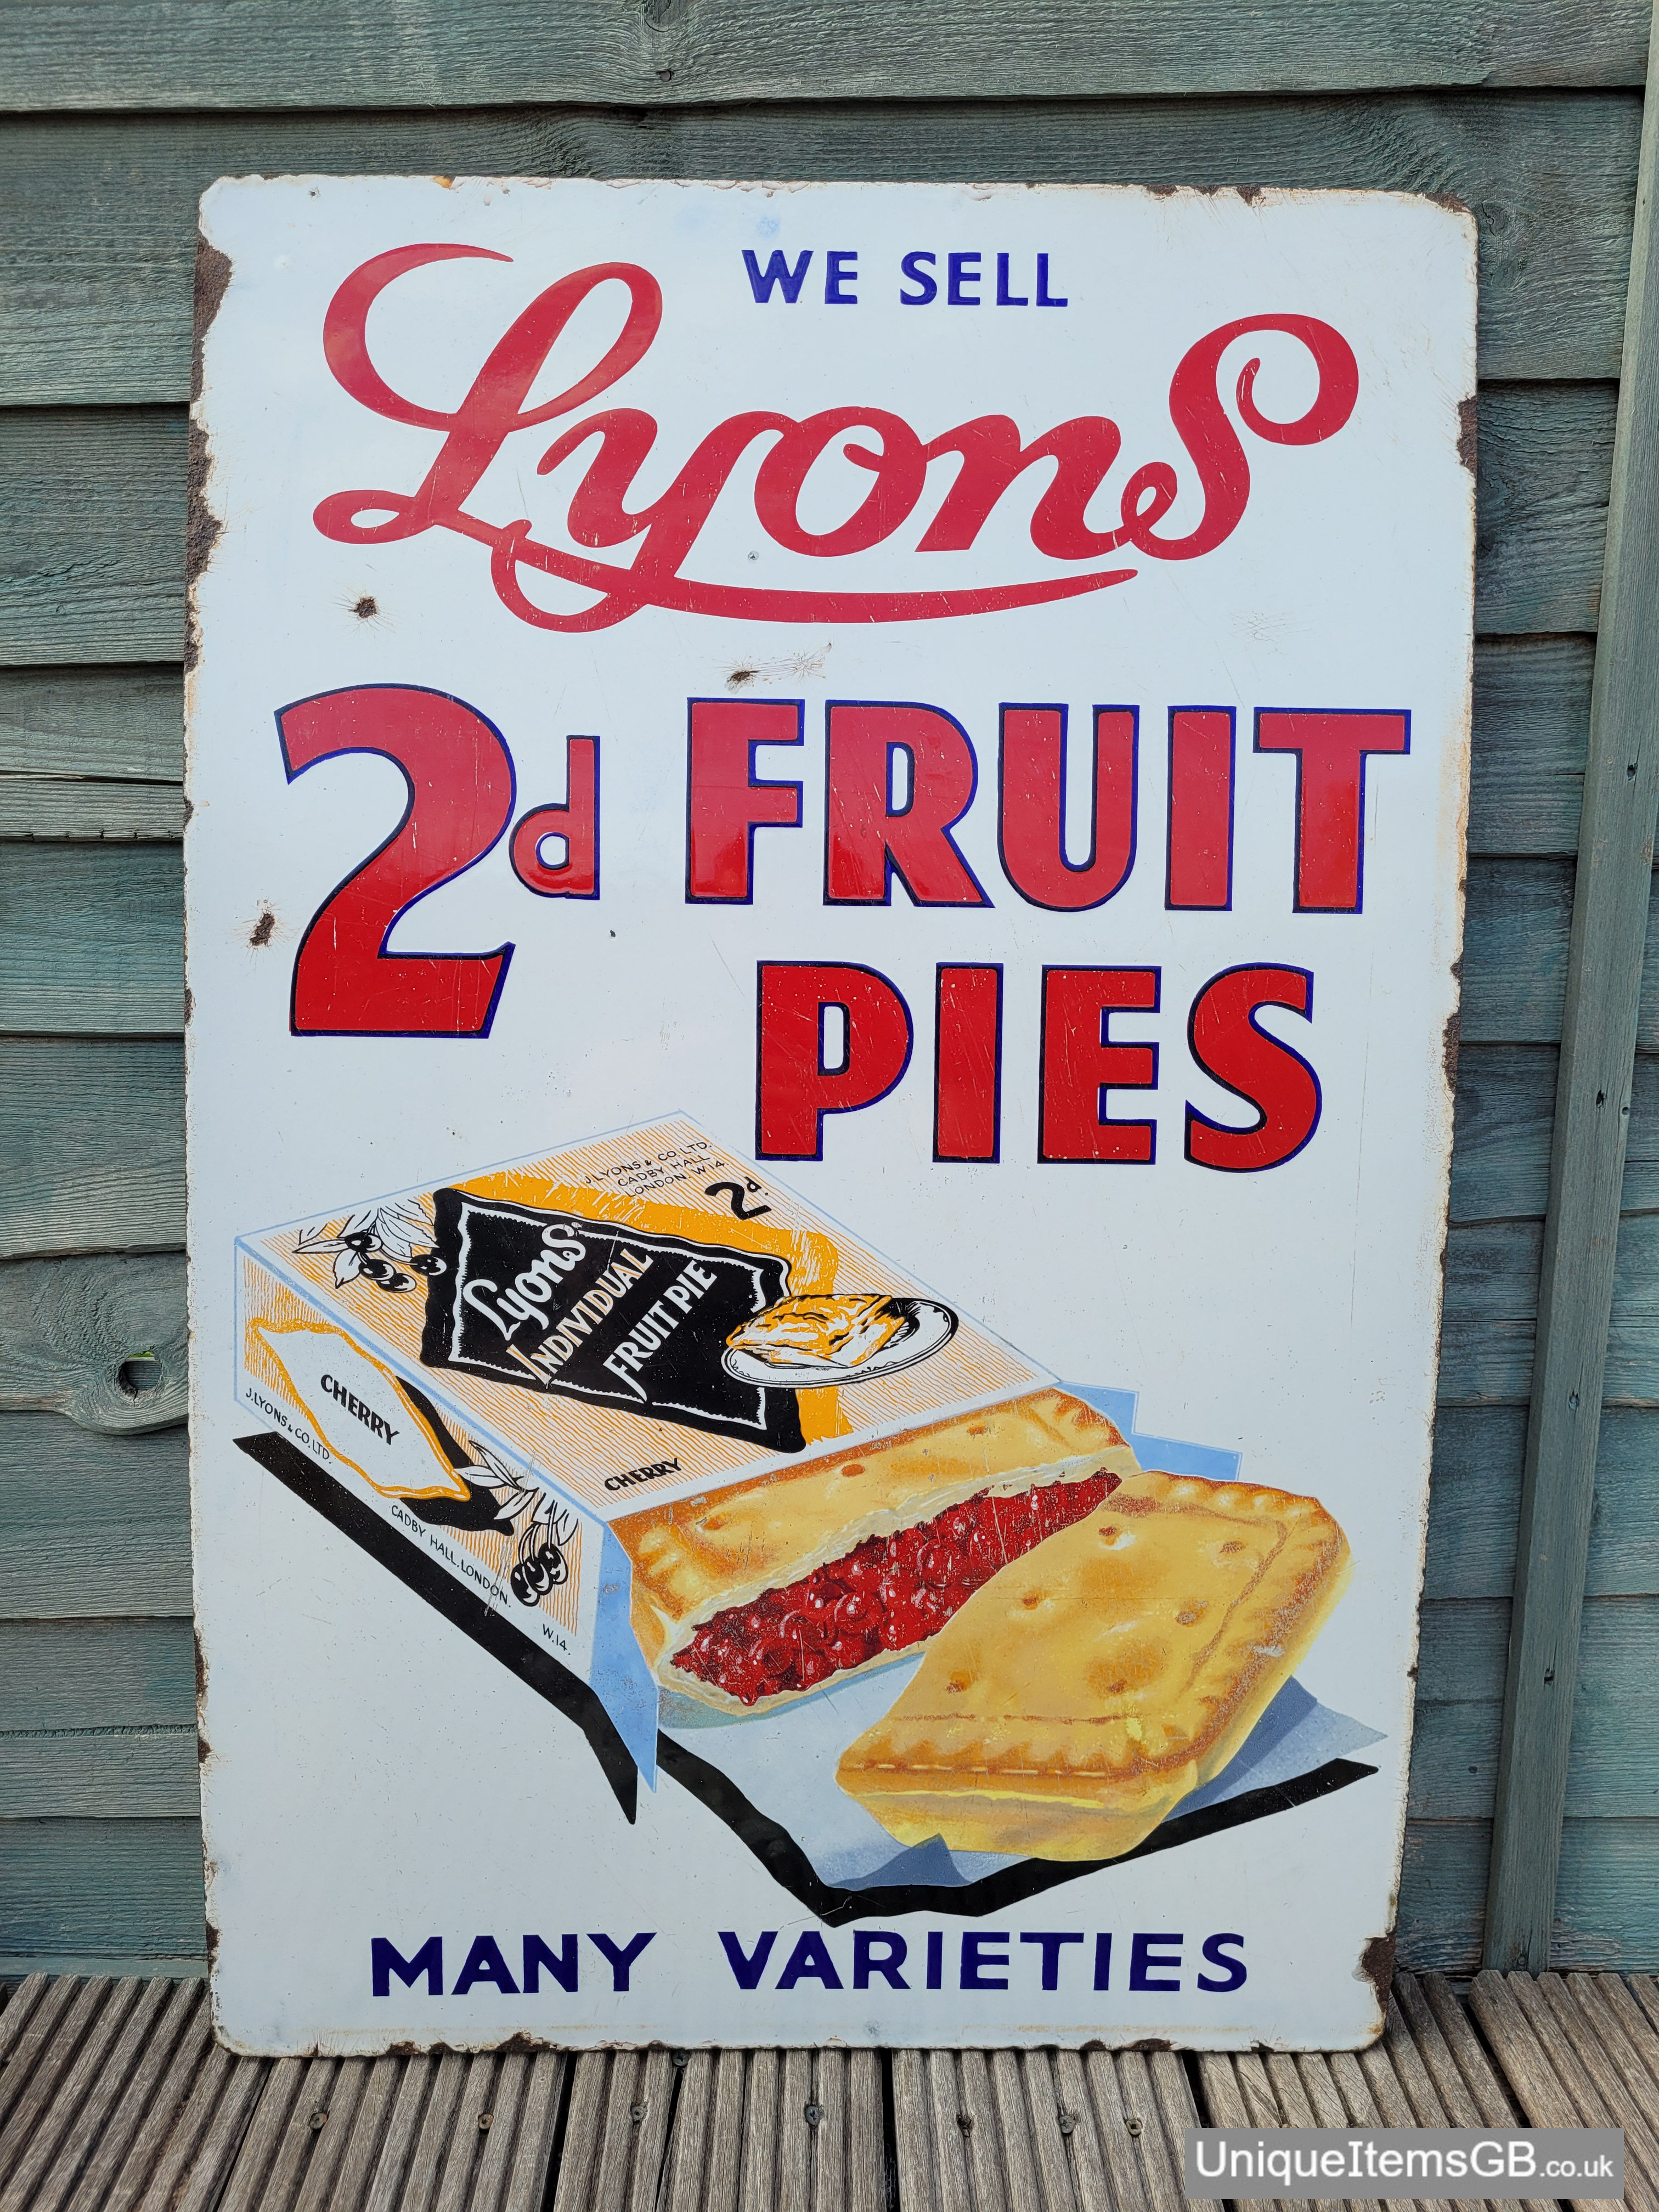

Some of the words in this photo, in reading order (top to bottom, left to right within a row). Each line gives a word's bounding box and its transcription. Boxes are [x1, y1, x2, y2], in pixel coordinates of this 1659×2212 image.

[742, 249, 859, 304] WE
[900, 251, 1069, 308] SELL
[313, 242, 1359, 634] Lyons
[273, 682, 601, 1039] 2d
[685, 697, 1412, 914] FRUIT
[755, 960, 1323, 1173] PIES
[617, 1167, 665, 1187] CADBY
[671, 1154, 710, 1170] HALL
[624, 1172, 691, 1198] LONDON.
[506, 1248, 654, 1385] INDIVIDUAL
[603, 1300, 679, 1402] FRUIT
[663, 1260, 718, 1314] PIE
[287, 1424, 293, 1433] &
[320, 1374, 400, 1446] CHERRY
[604, 1457, 682, 1491] CHERRY
[391, 1505, 426, 1538] CADBY
[371, 1932, 657, 1997] MANY
[717, 1931, 1248, 1992] VARIETIES
